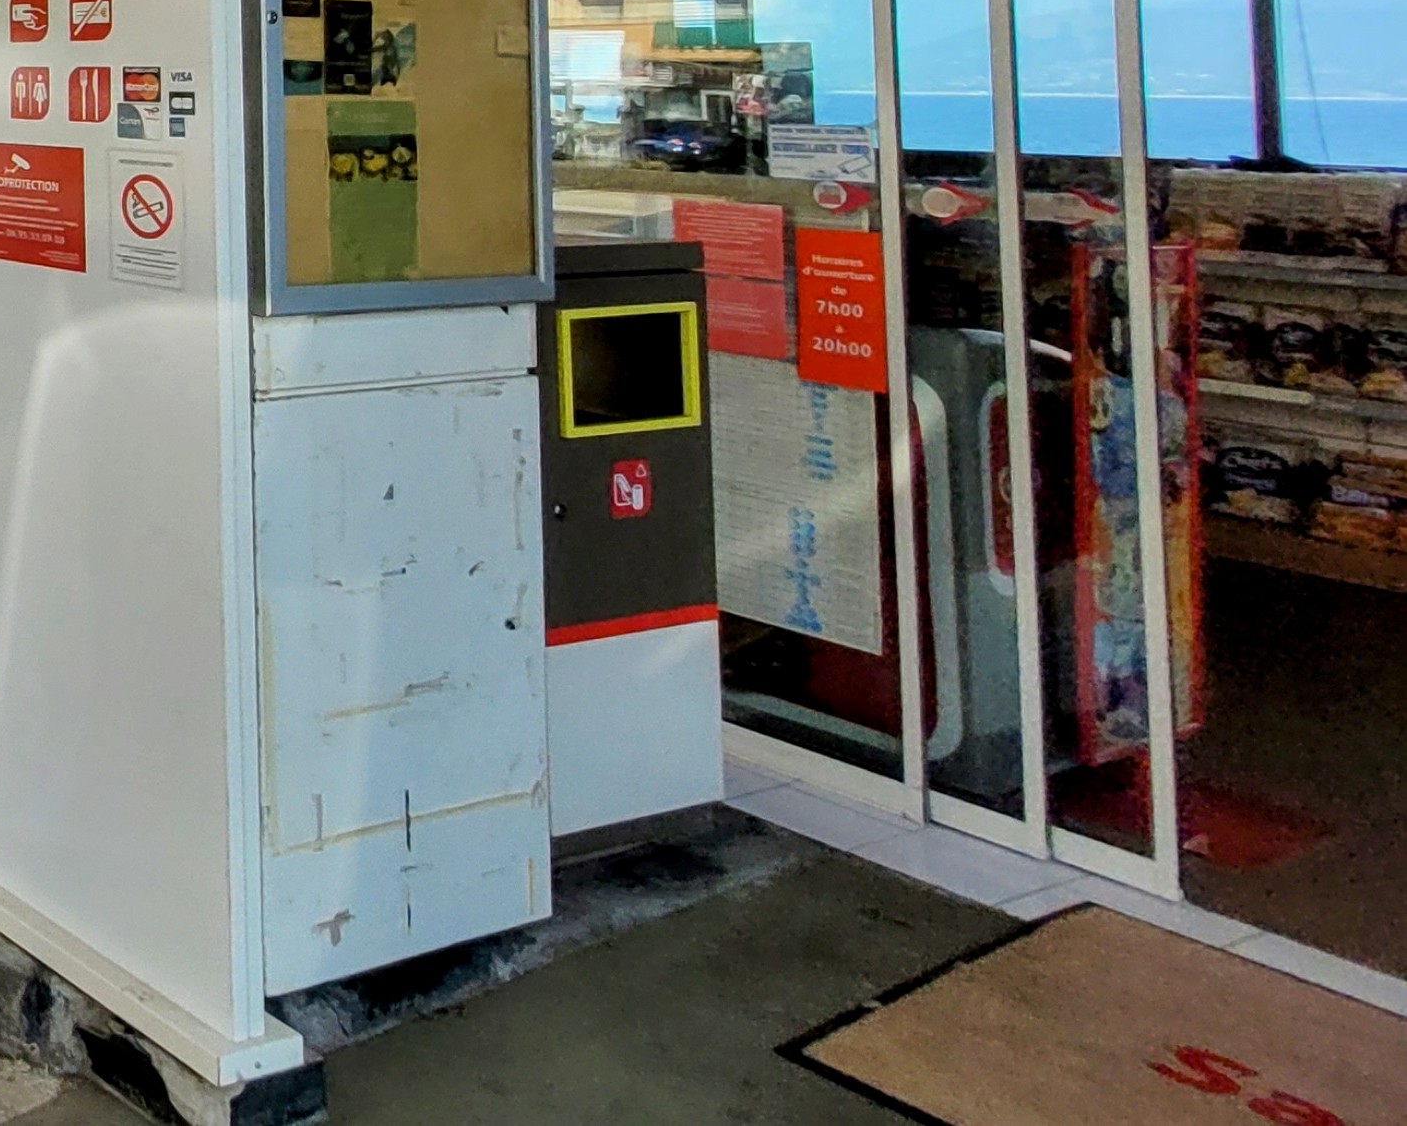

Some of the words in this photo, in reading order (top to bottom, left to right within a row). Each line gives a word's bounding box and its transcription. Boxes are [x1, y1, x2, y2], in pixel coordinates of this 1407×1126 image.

[171, 72, 193, 82] VISA
[831, 285, 847, 296] de
[816, 300, 864, 318] 7h00
[813, 337, 872, 357] 20h00
